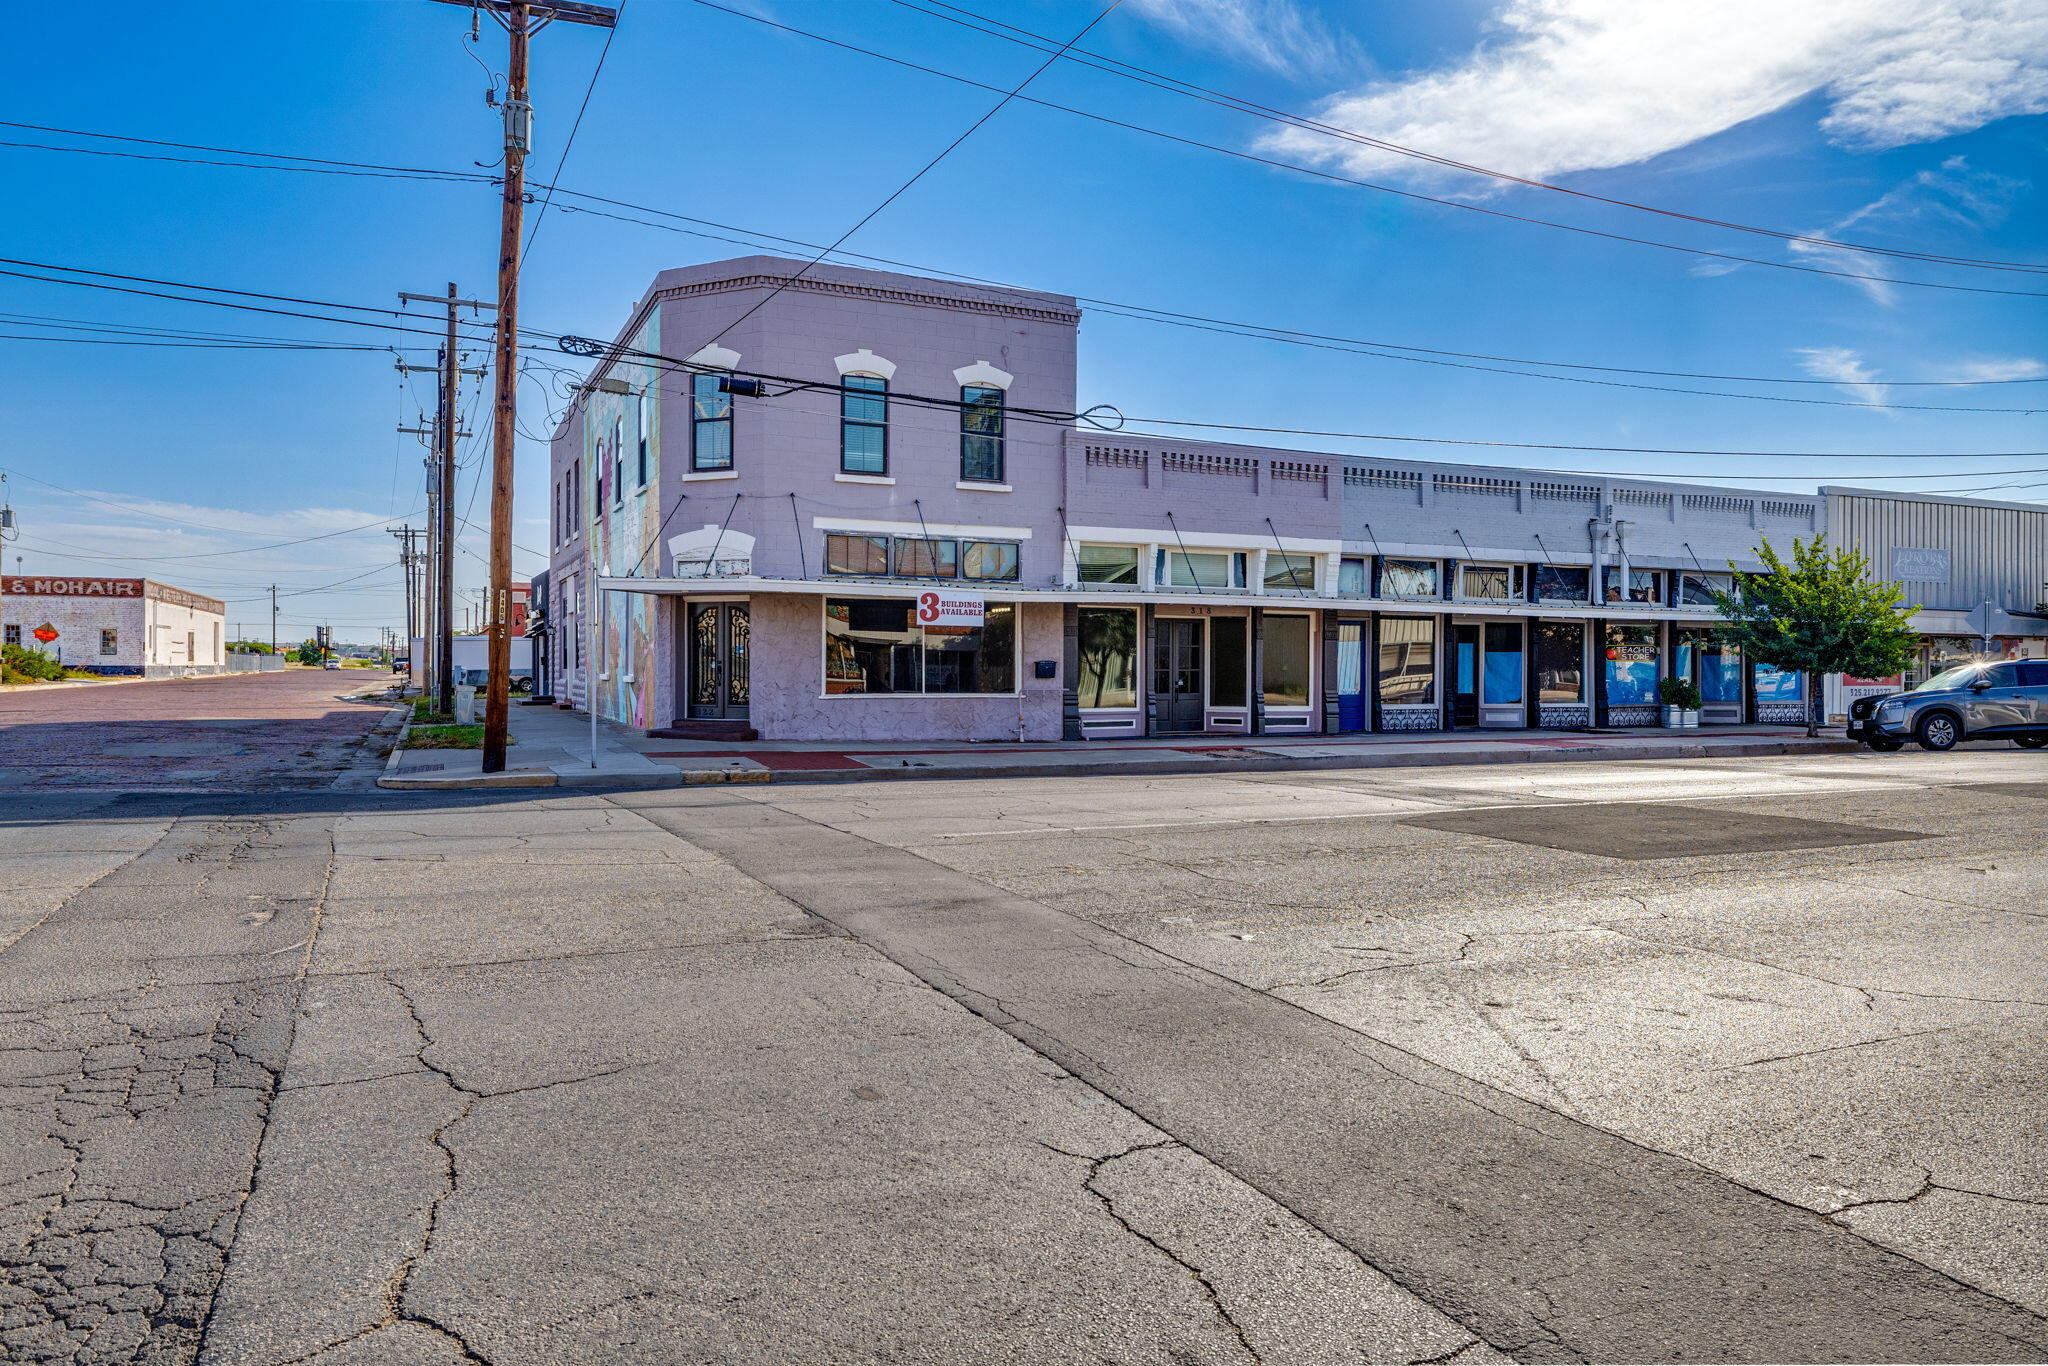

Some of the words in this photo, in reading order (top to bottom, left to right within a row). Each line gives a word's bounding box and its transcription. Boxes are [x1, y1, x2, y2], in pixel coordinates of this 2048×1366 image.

[11, 580, 27, 593] &
[34, 580, 134, 596] MOHAIR
[919, 592, 940, 622] 3
[941, 600, 983, 609] BUILDINGS
[1190, 606, 1212, 614] 318
[1616, 646, 1656, 654] TEACHER
